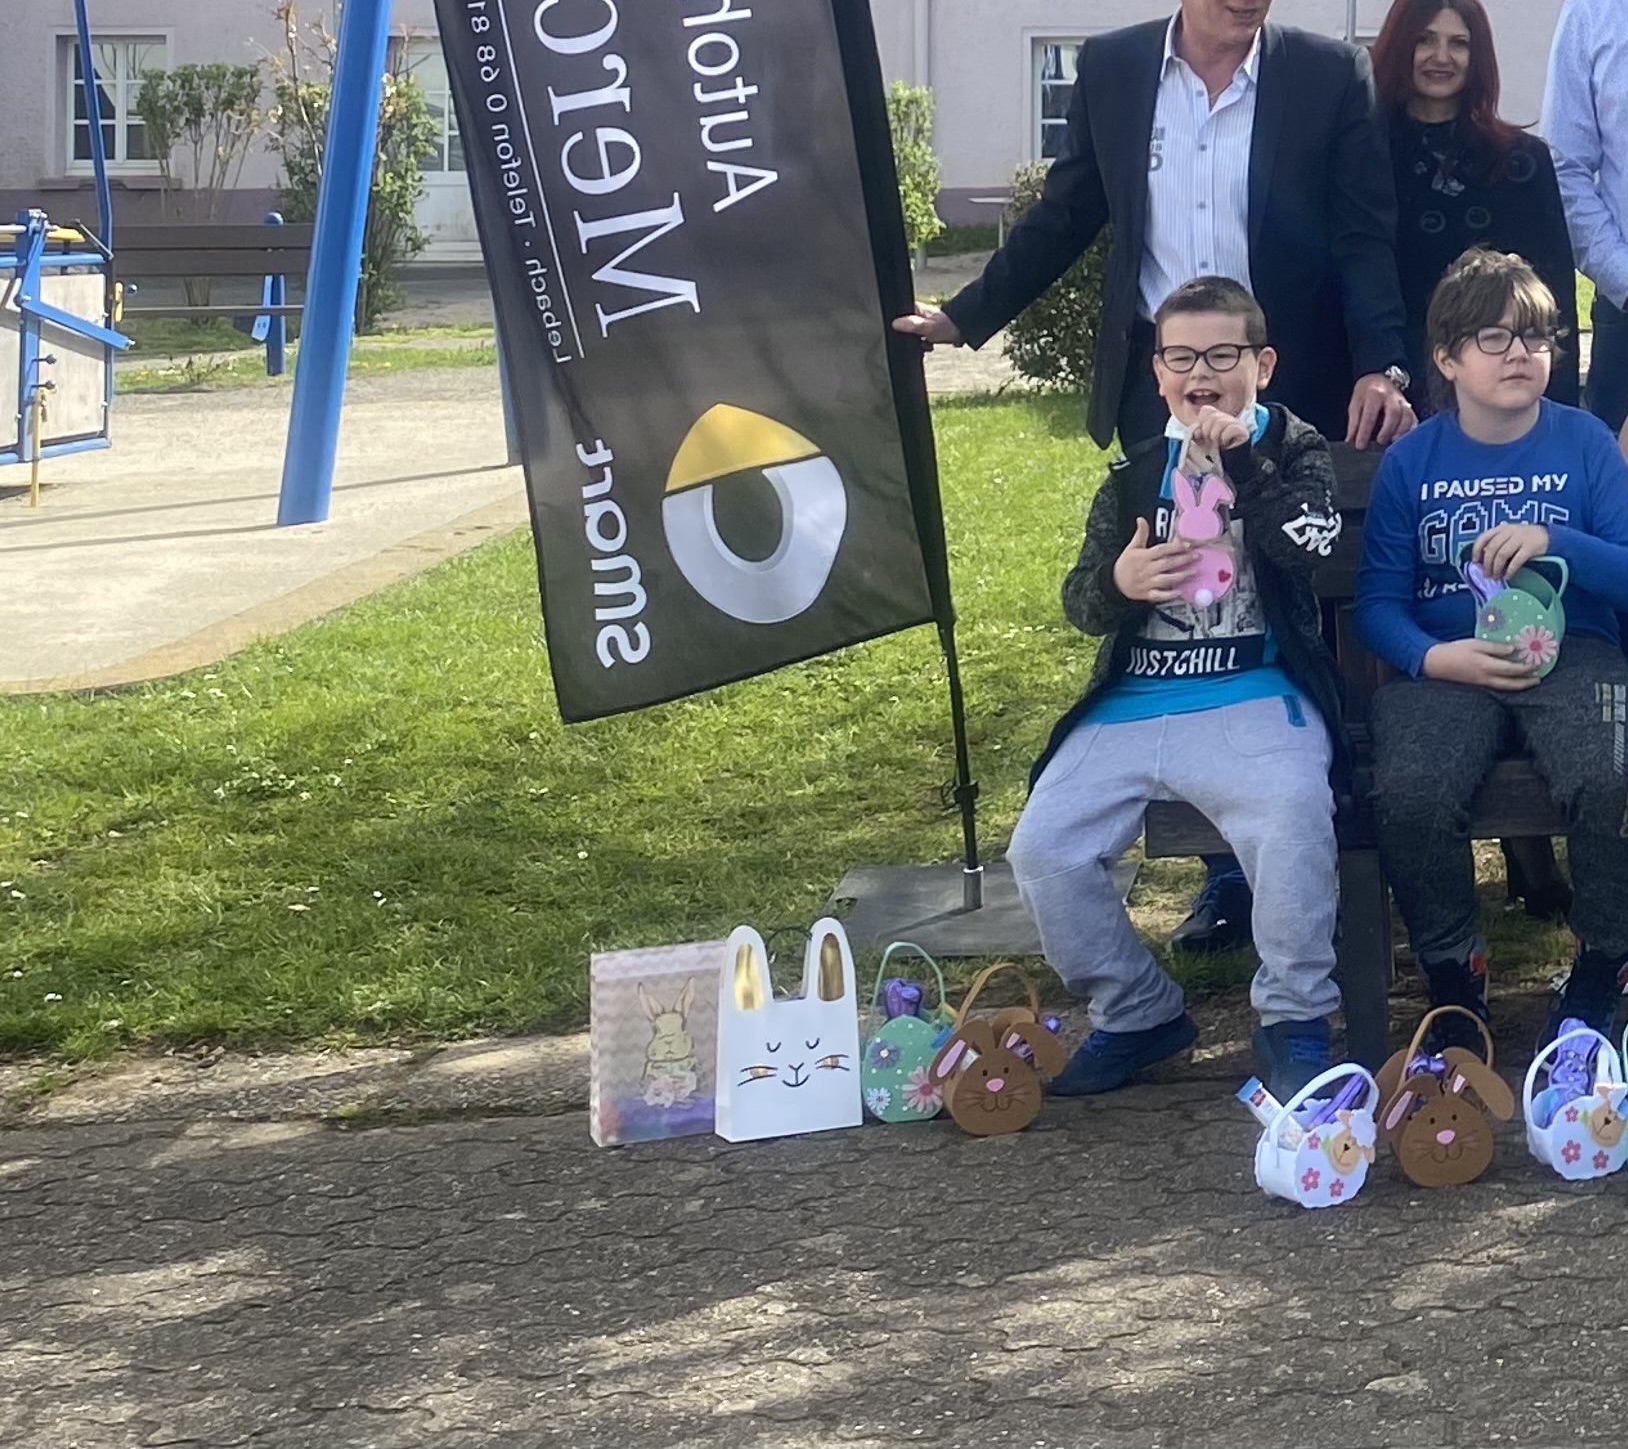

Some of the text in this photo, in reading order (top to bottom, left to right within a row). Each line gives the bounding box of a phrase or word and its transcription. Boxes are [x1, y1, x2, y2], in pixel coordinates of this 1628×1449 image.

[1420, 472, 1568, 501] I PAUSED MY
